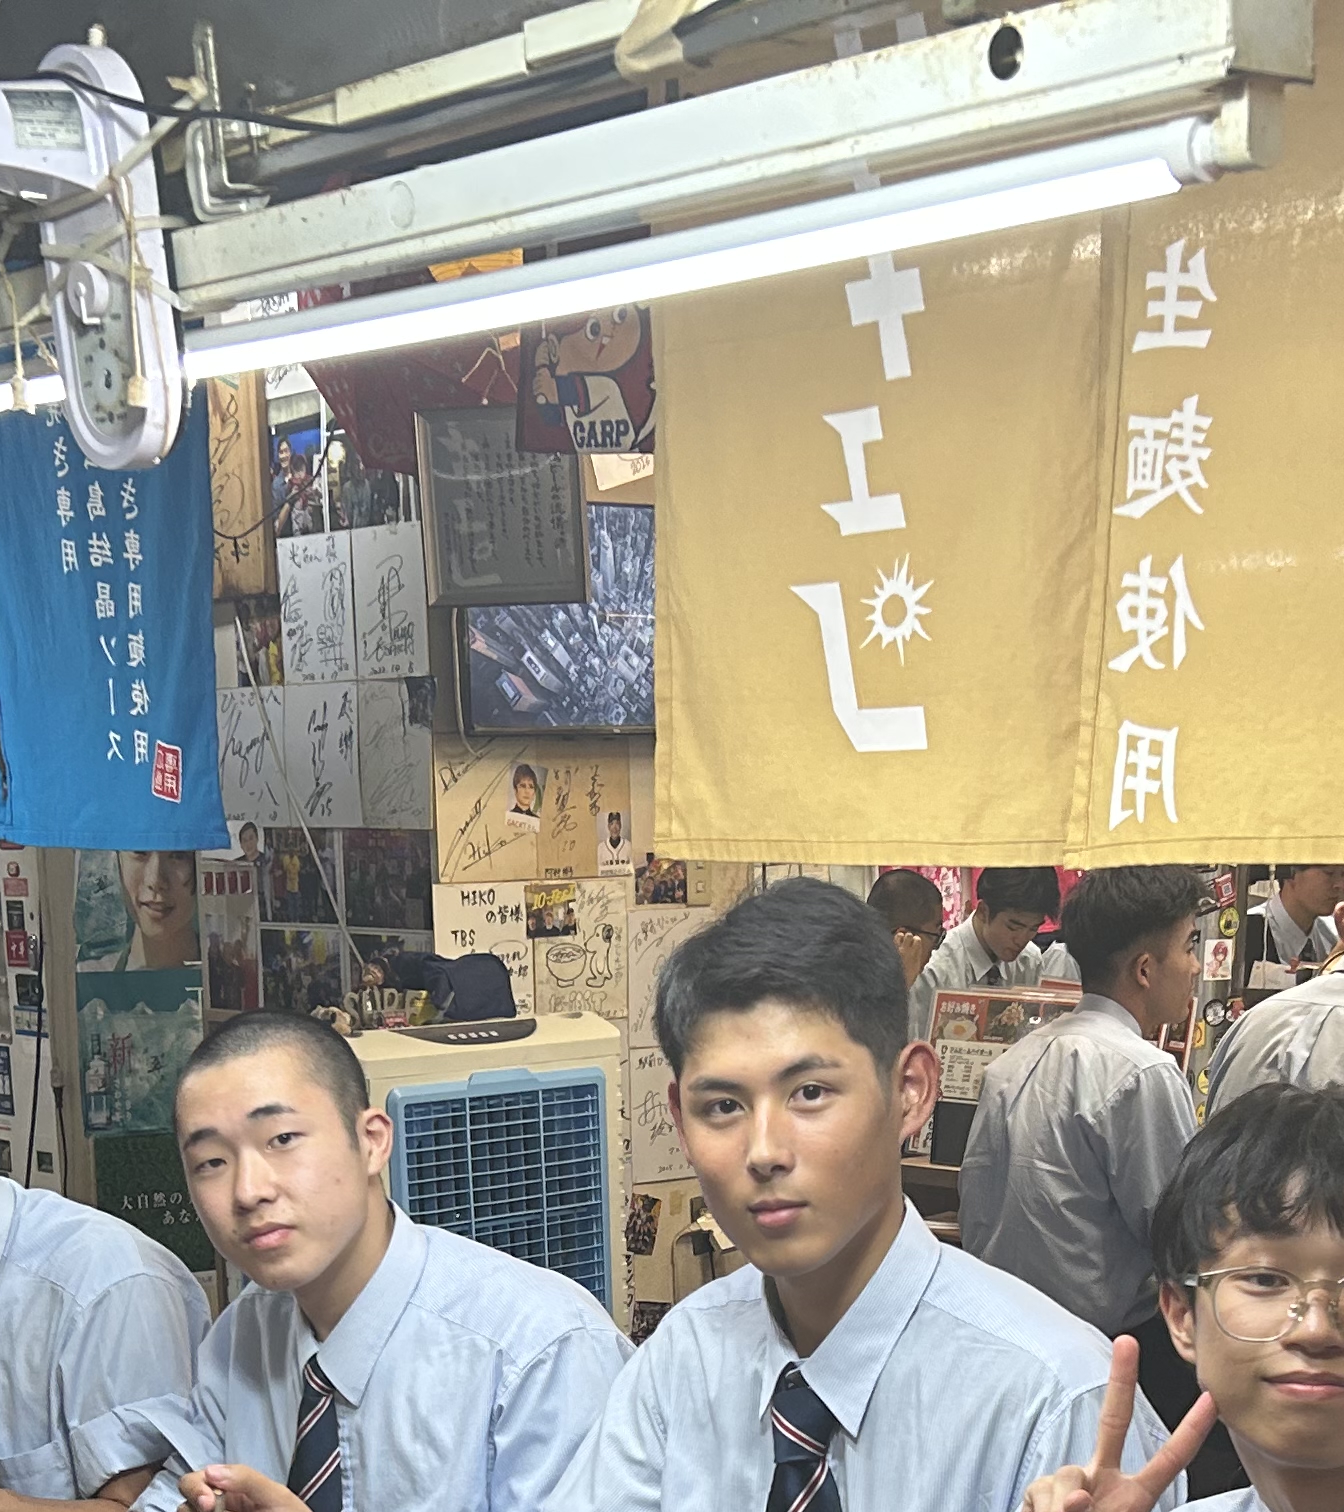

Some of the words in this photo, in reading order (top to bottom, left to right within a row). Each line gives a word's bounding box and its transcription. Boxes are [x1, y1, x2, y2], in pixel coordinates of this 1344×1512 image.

[573, 419, 630, 449] CARP
[460, 889, 496, 907] HIKO
[450, 929, 476, 948] TBS
[121, 1191, 190, 1210] 大自然の
